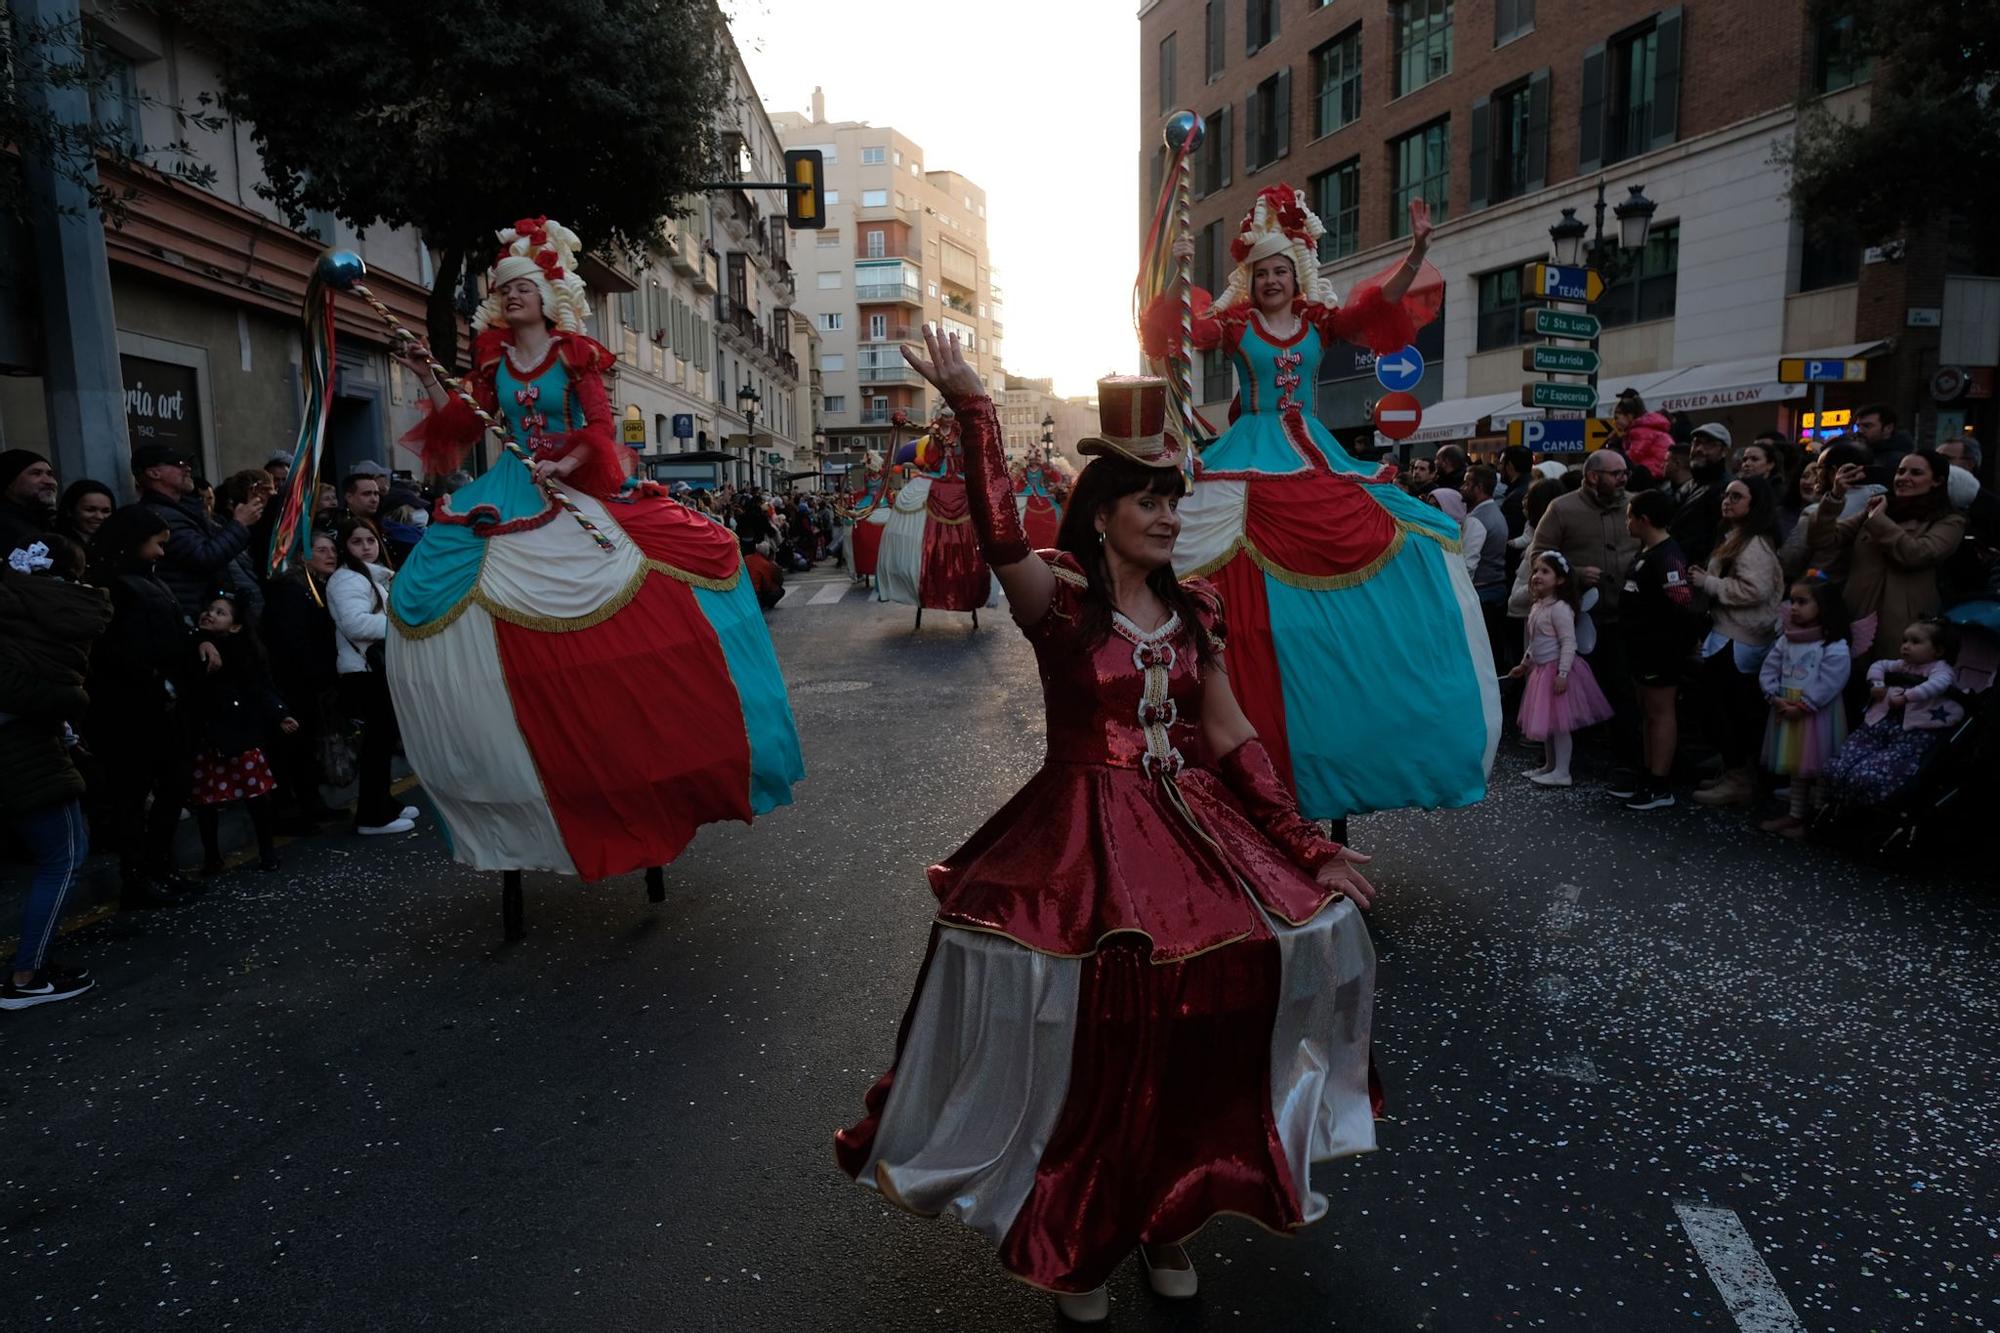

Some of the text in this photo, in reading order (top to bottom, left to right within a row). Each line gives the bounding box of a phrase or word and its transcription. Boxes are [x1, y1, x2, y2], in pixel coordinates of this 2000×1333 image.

[1545, 266, 1560, 295] P
[1536, 352, 1584, 366] Plaza Arriola
[1810, 361, 1822, 380] P
[123, 381, 184, 420] ria art
[1662, 388, 1762, 411] SERVED ALL DAY
[1523, 421, 1584, 452] P CAMAS
